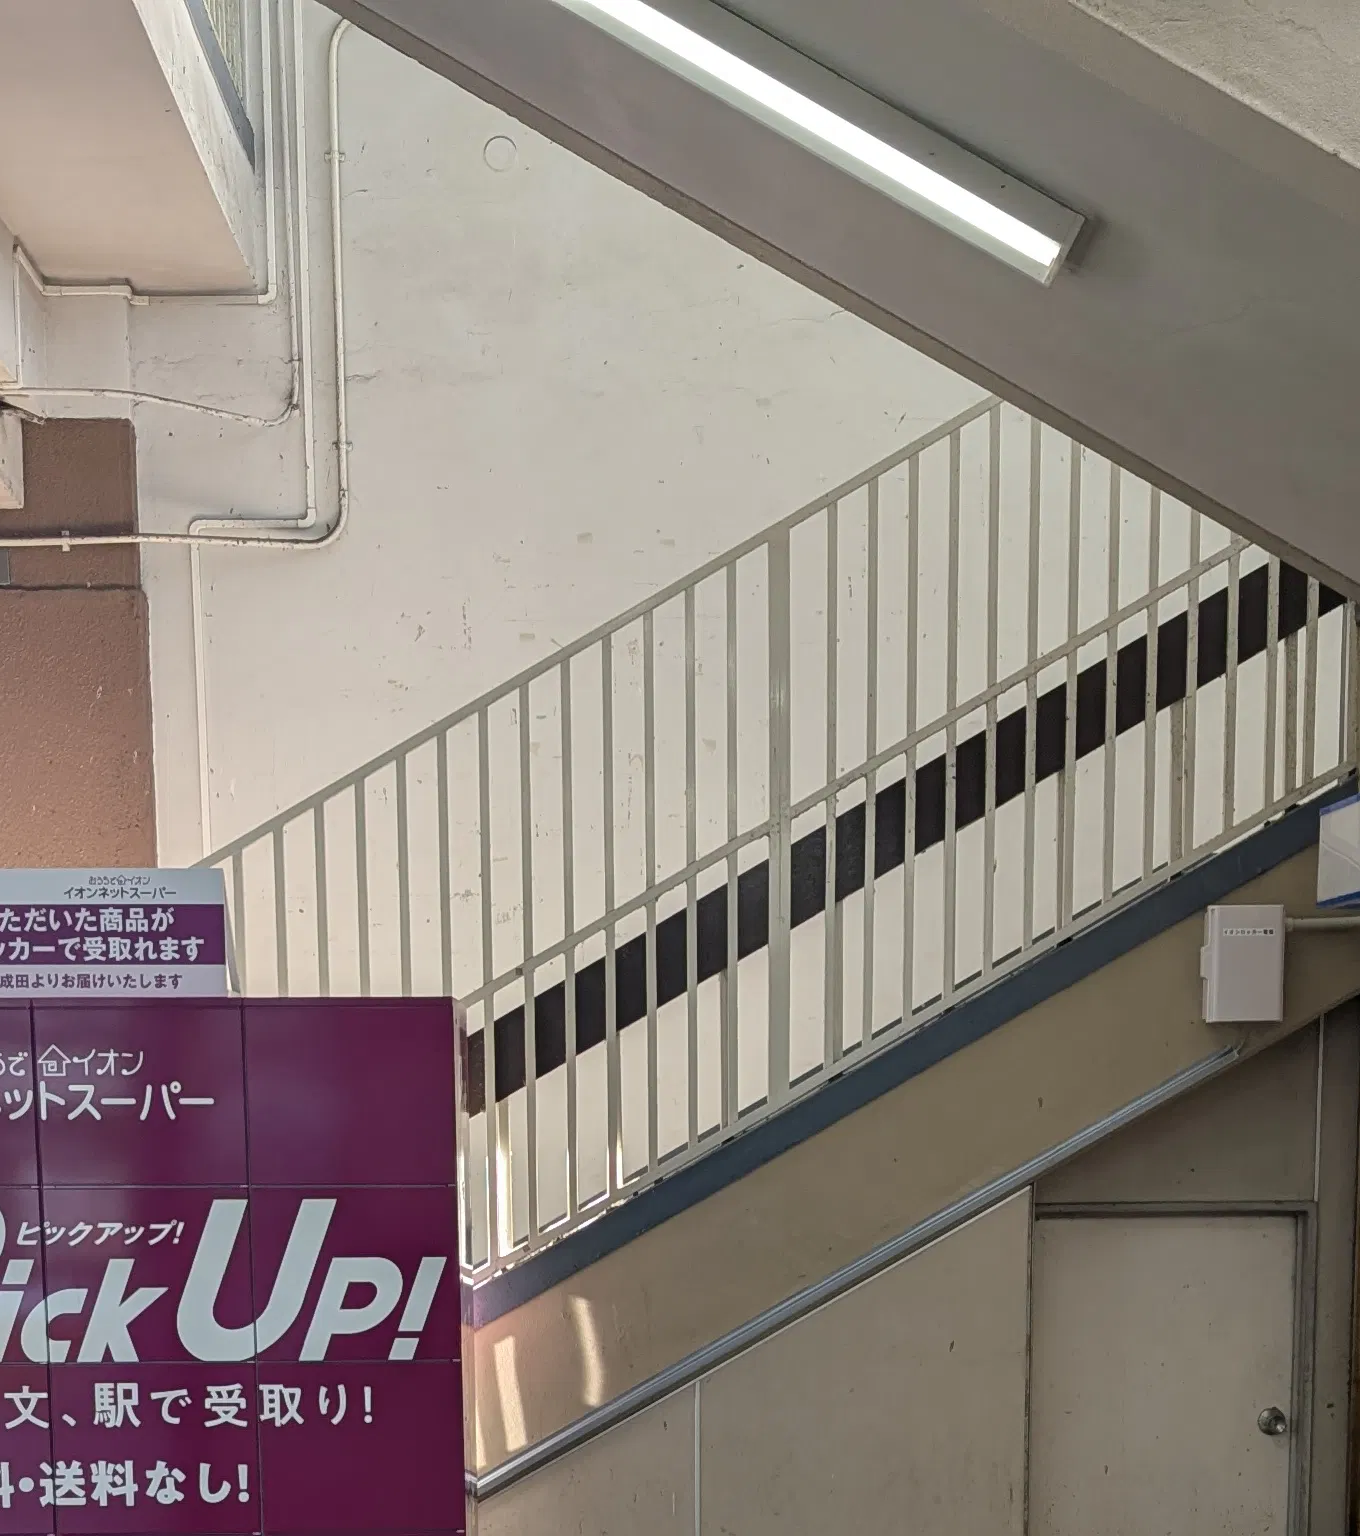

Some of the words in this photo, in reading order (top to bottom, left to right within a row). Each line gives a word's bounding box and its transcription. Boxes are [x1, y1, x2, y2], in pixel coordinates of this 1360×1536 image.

[63, 885, 177, 900] イオンネットスーパー
[72, 1047, 144, 1077] イオン
[17, 1220, 185, 1247] ピックアップ!
